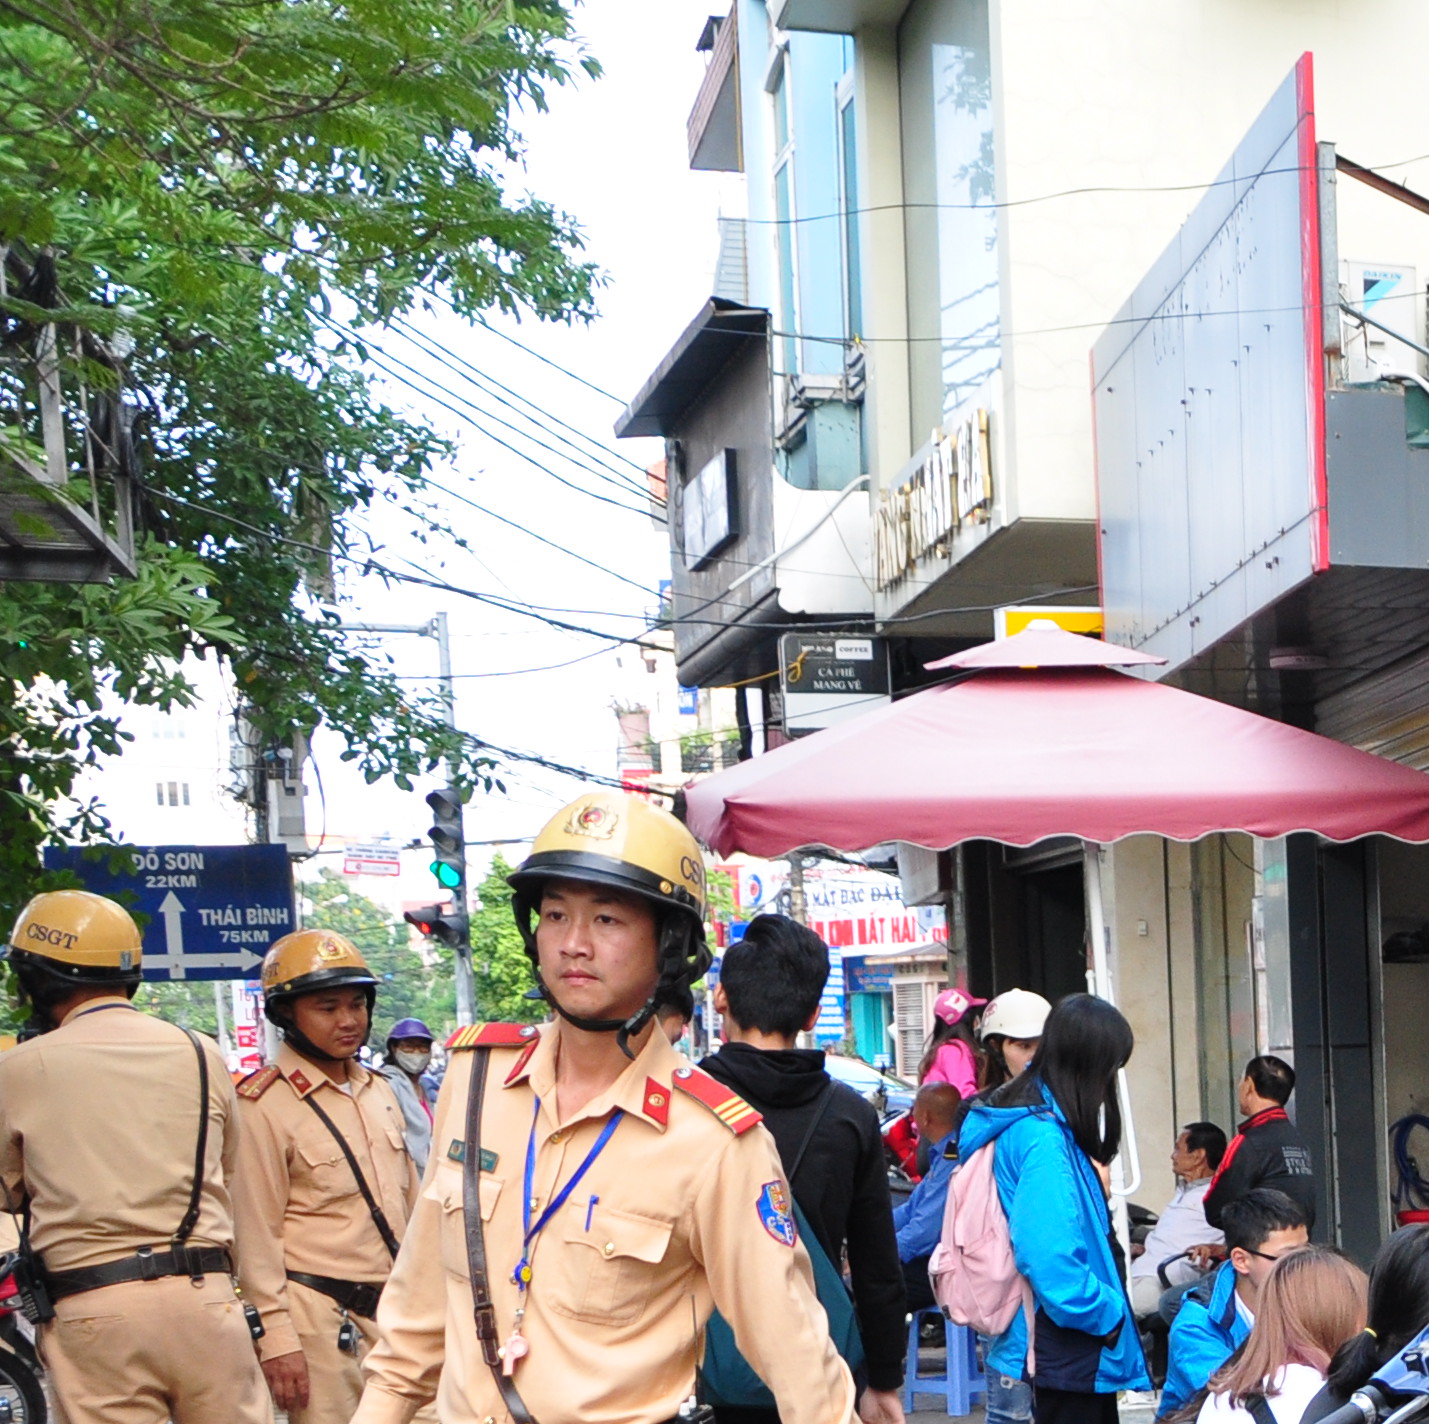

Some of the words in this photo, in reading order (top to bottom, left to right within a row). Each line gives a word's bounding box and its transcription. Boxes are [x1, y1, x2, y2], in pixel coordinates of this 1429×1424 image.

[814, 680, 845, 690] MANG
[165, 852, 204, 871] SƠN
[145, 875, 197, 888] 22KM
[199, 903, 242, 926] THÁI
[247, 904, 290, 925] BÌNH
[26, 923, 78, 950] CSGT
[220, 930, 269, 943] 75KM
